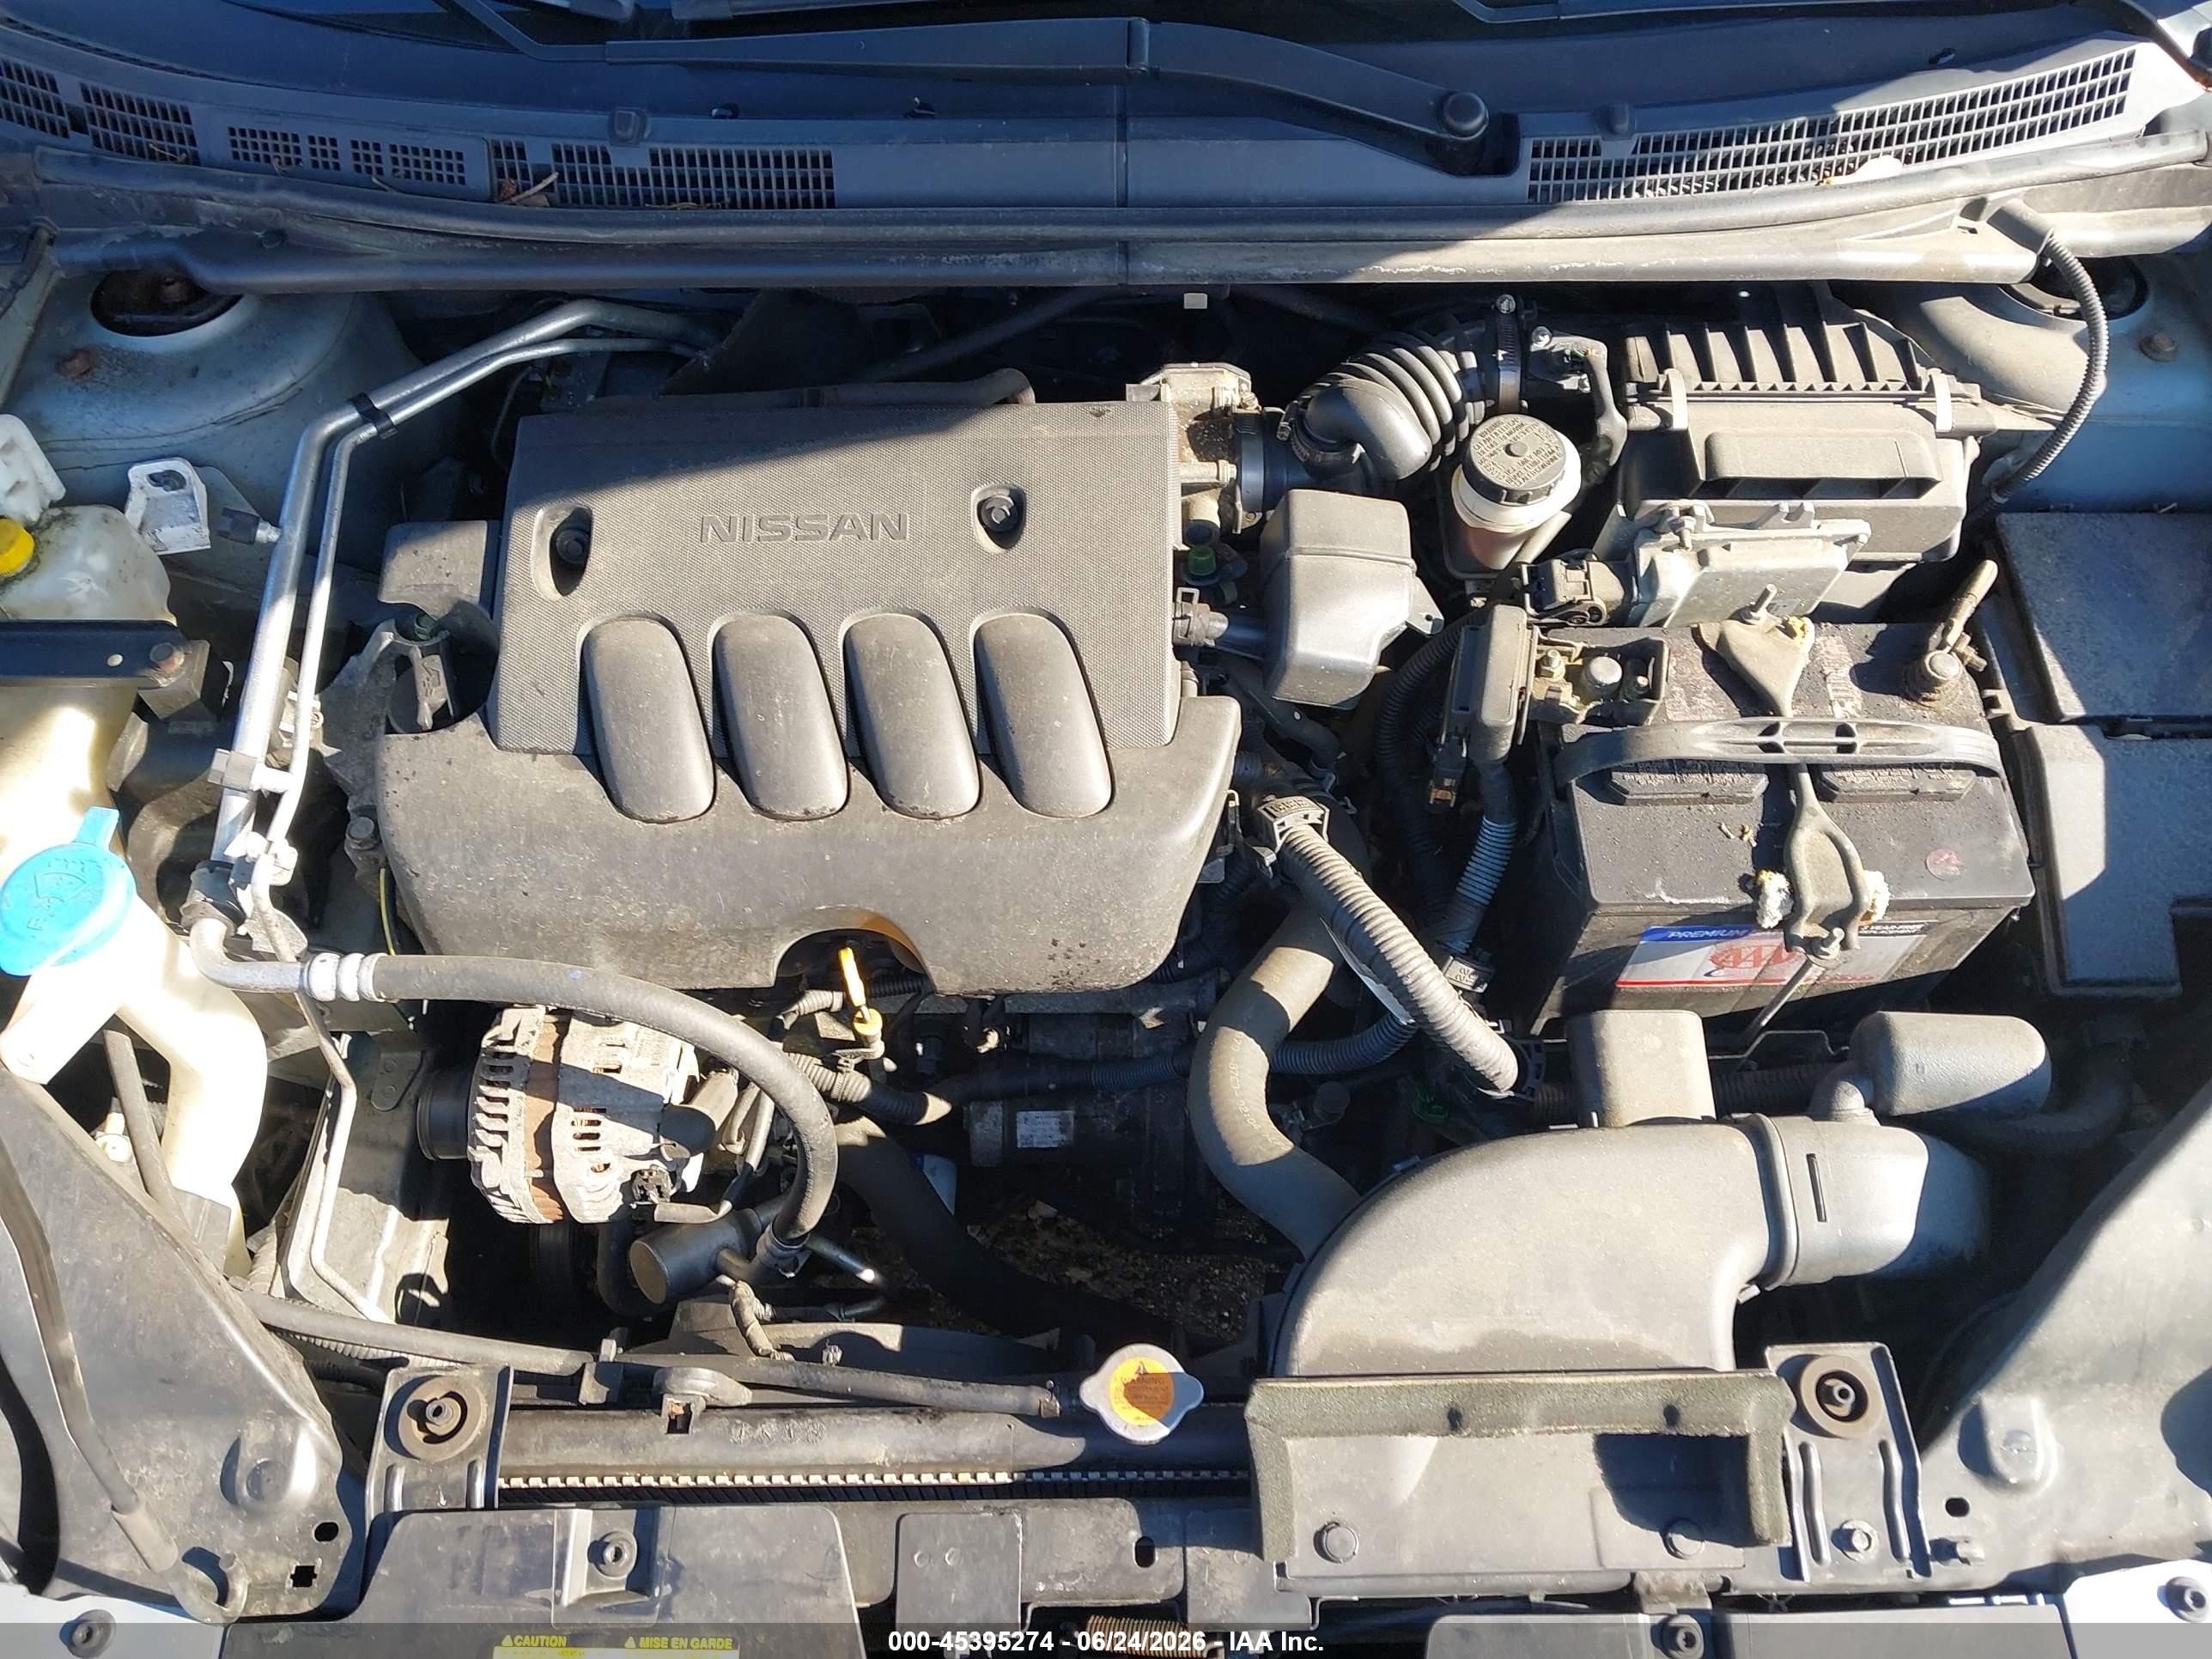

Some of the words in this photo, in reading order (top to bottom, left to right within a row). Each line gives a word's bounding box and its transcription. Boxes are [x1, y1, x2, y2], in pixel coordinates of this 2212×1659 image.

[700, 514, 908, 544] NISSAN
[1668, 928, 1750, 939] PREMIUM
[514, 1634, 567, 1647] CAUTION
[639, 1637, 669, 1649] MISE
[671, 1637, 688, 1649] EN
[690, 1637, 733, 1649] GARDE
